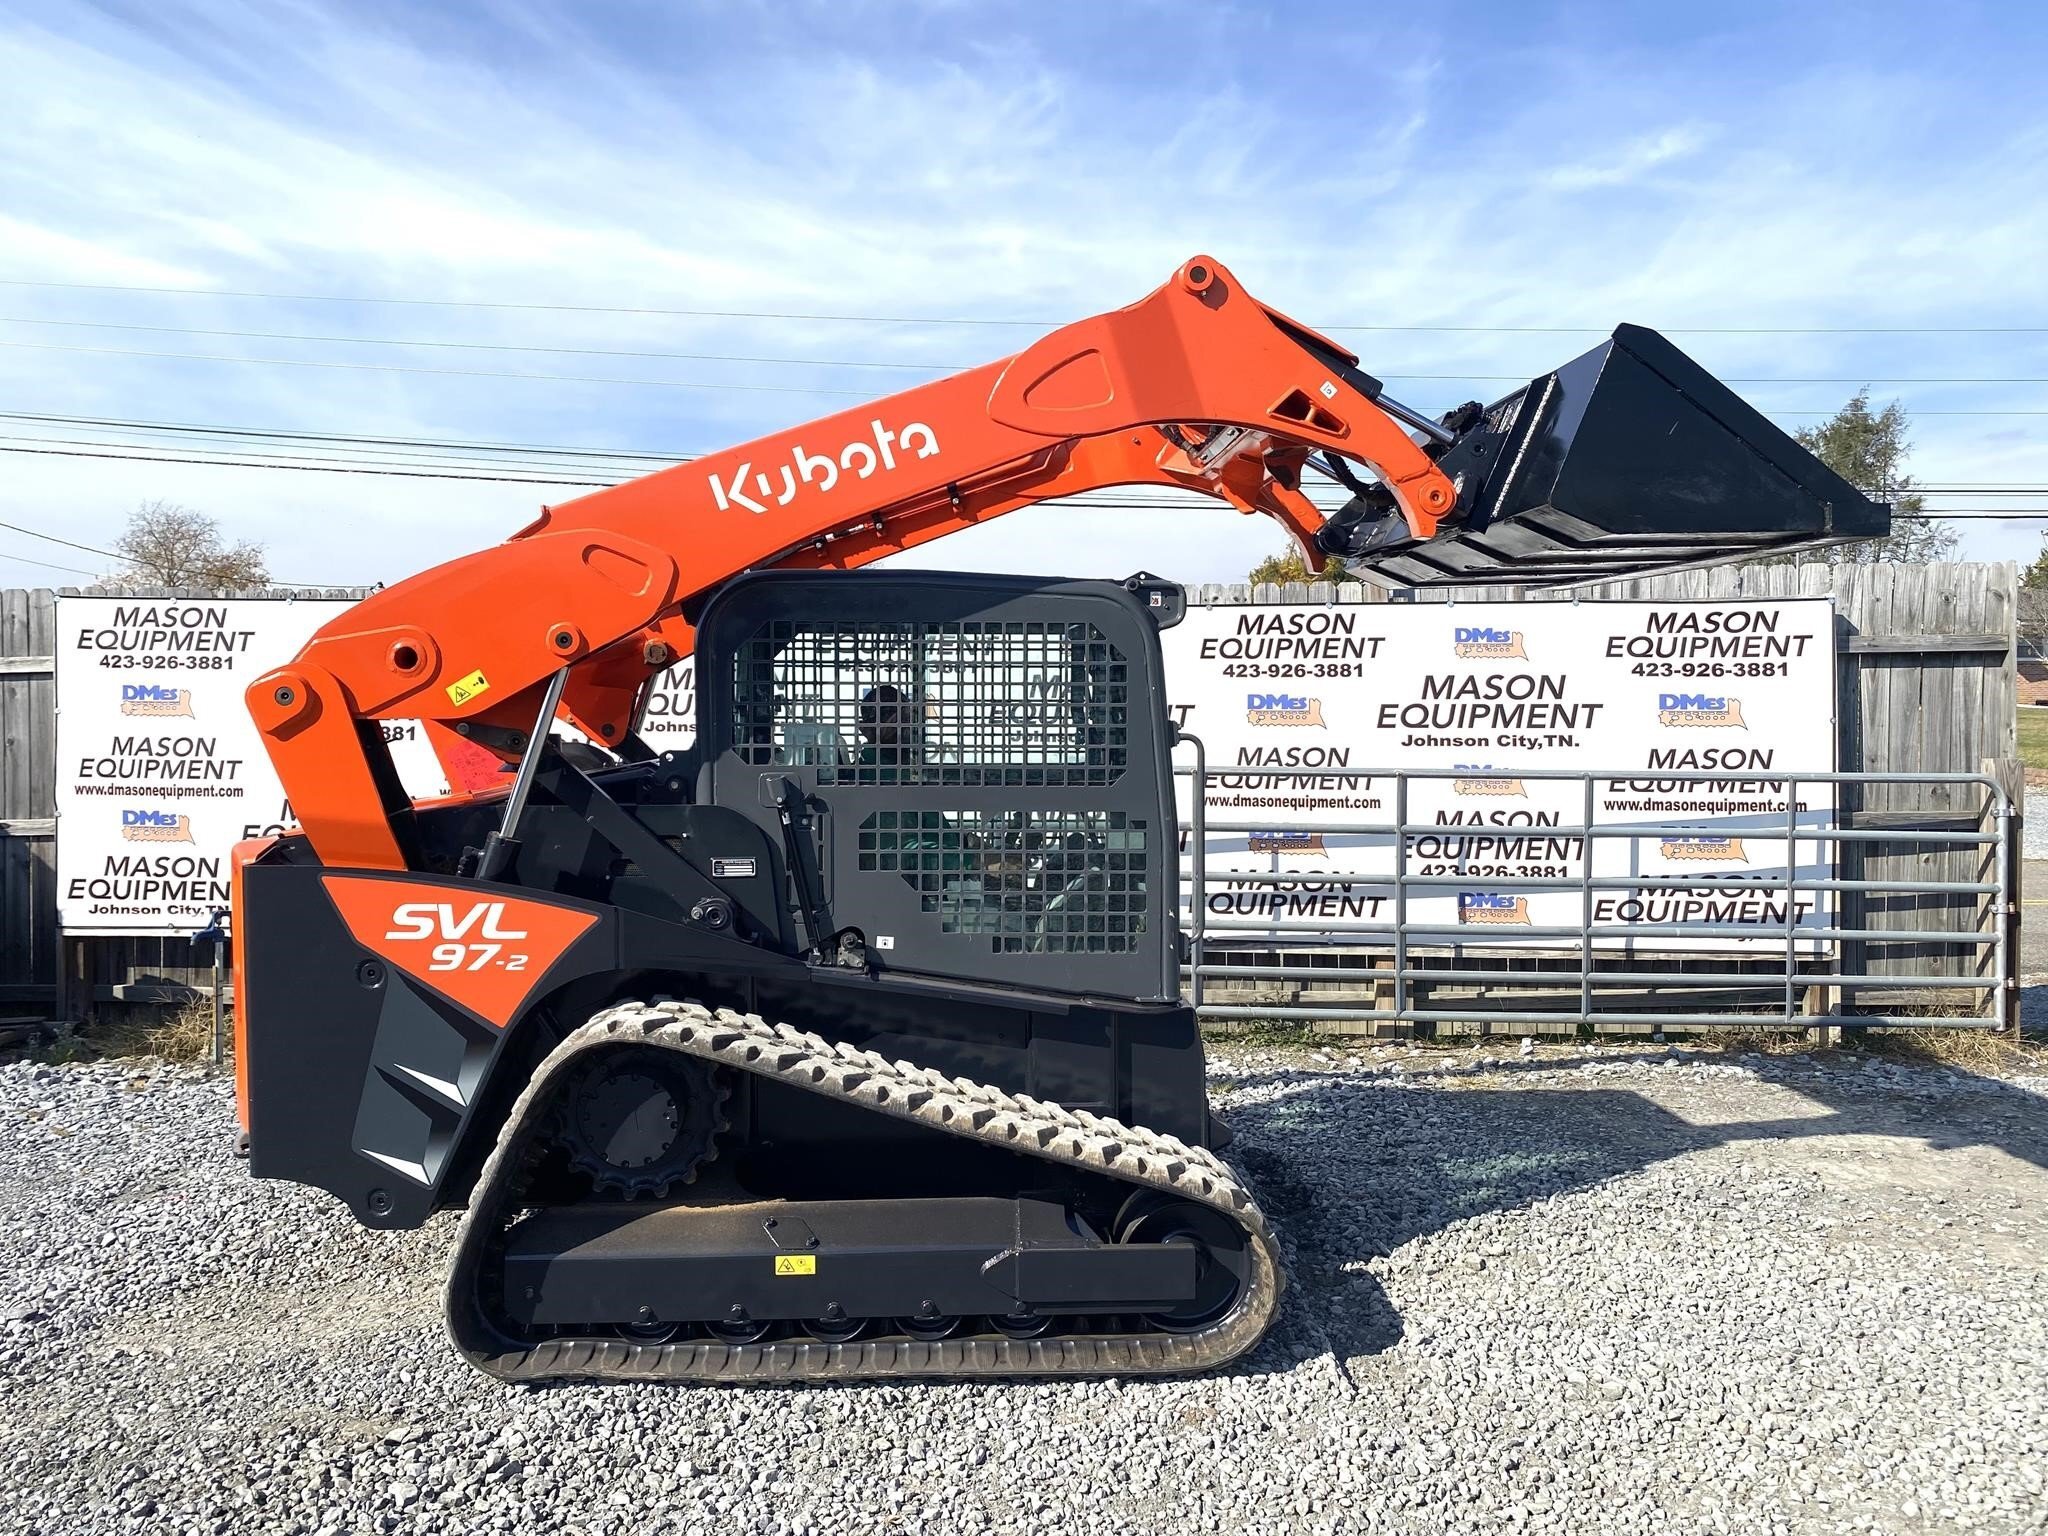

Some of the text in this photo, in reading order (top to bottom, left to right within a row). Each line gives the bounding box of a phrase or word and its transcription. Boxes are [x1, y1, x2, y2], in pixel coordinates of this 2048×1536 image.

[708, 419, 941, 514] Kubota
[113, 607, 227, 628] MASON
[1237, 613, 1356, 635] MASON
[1646, 611, 1780, 634] MASON
[77, 629, 255, 652] EQUIPMENT
[1200, 637, 1386, 659] EQUIPMENT
[1605, 635, 1813, 658] EQUIPMENT
[99, 655, 233, 670] 423-926-3881
[1222, 663, 1363, 678] 423-926-3881
[1631, 662, 1788, 677] 423-926-3881
[1421, 674, 1567, 700] MASON
[1377, 703, 1604, 729] EQUIPMENT
[111, 736, 216, 757] MASON
[1401, 735, 1580, 750] Johnson City,TN.
[1237, 747, 1350, 767] MASON
[1648, 749, 1773, 770] MASON
[79, 758, 242, 780] EQUIPMENT
[74, 783, 244, 799] www.dmasonequipment.com
[1609, 779, 1783, 794] EQUIPMEN
[1435, 810, 1560, 827] MASON
[1405, 835, 1585, 861] EQUIPMENT
[104, 856, 220, 878] MASON
[68, 879, 231, 901] EQUIPMEN
[89, 904, 161, 915] Johnson
[1188, 892, 1388, 918] QUIPMENT
[1594, 899, 1814, 925] EQUIPMENT
[384, 902, 528, 940] SVL
[428, 943, 529, 971] 97-2
